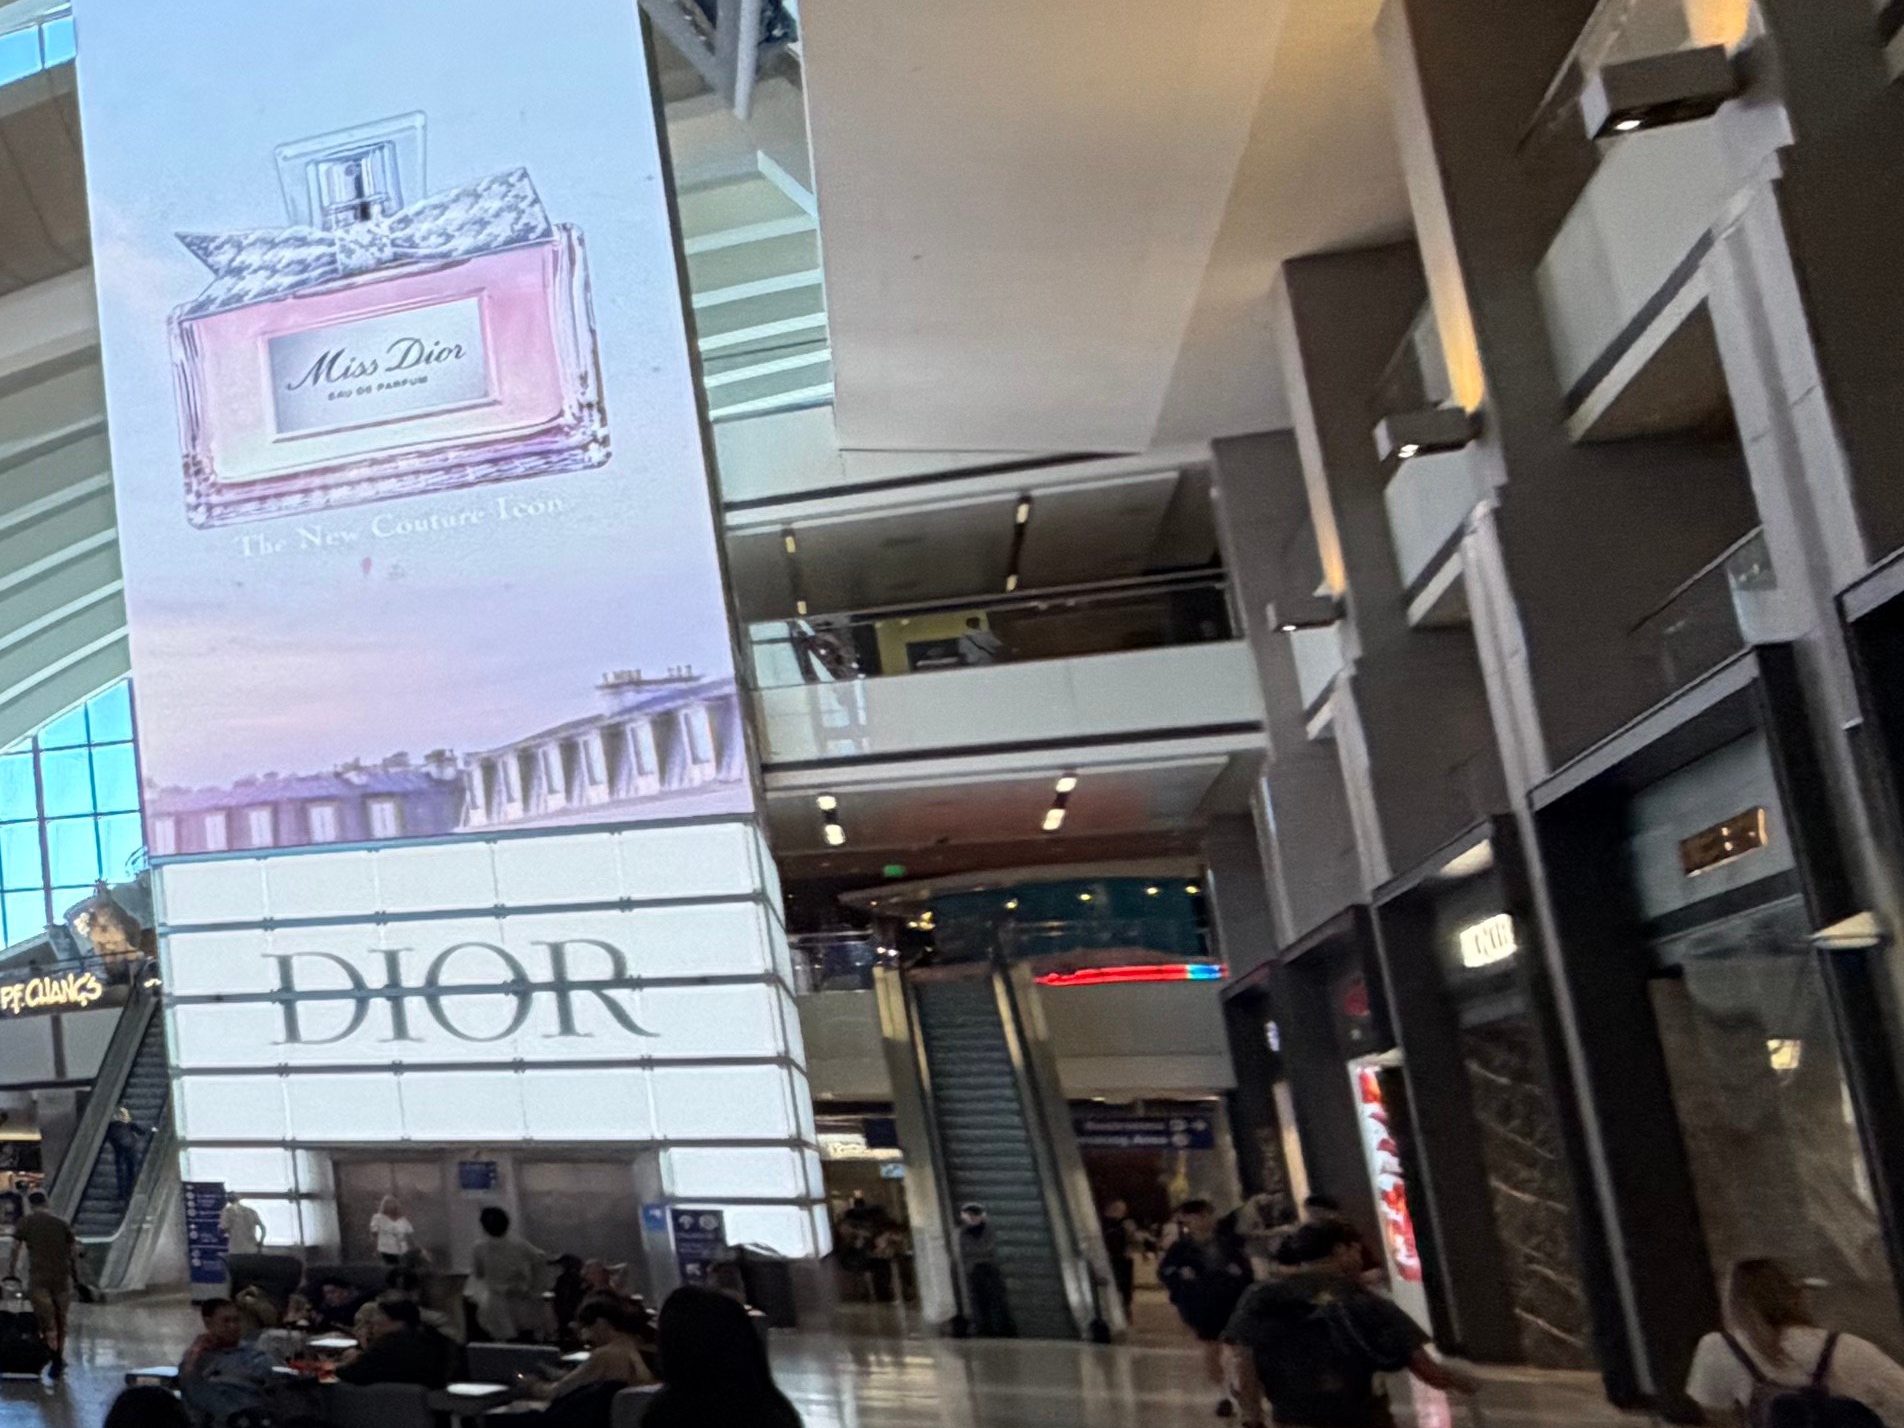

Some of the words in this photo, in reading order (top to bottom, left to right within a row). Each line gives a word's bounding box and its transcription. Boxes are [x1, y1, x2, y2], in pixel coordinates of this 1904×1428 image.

[287, 348, 378, 391] Miss
[385, 337, 466, 373] Dior
[328, 390, 353, 401] EAU
[377, 375, 428, 392] PARFUM
[233, 533, 286, 557] The
[294, 525, 358, 550] New
[371, 509, 485, 539] Couture
[496, 497, 563, 520] Icon
[260, 939, 661, 1046] DIOR
